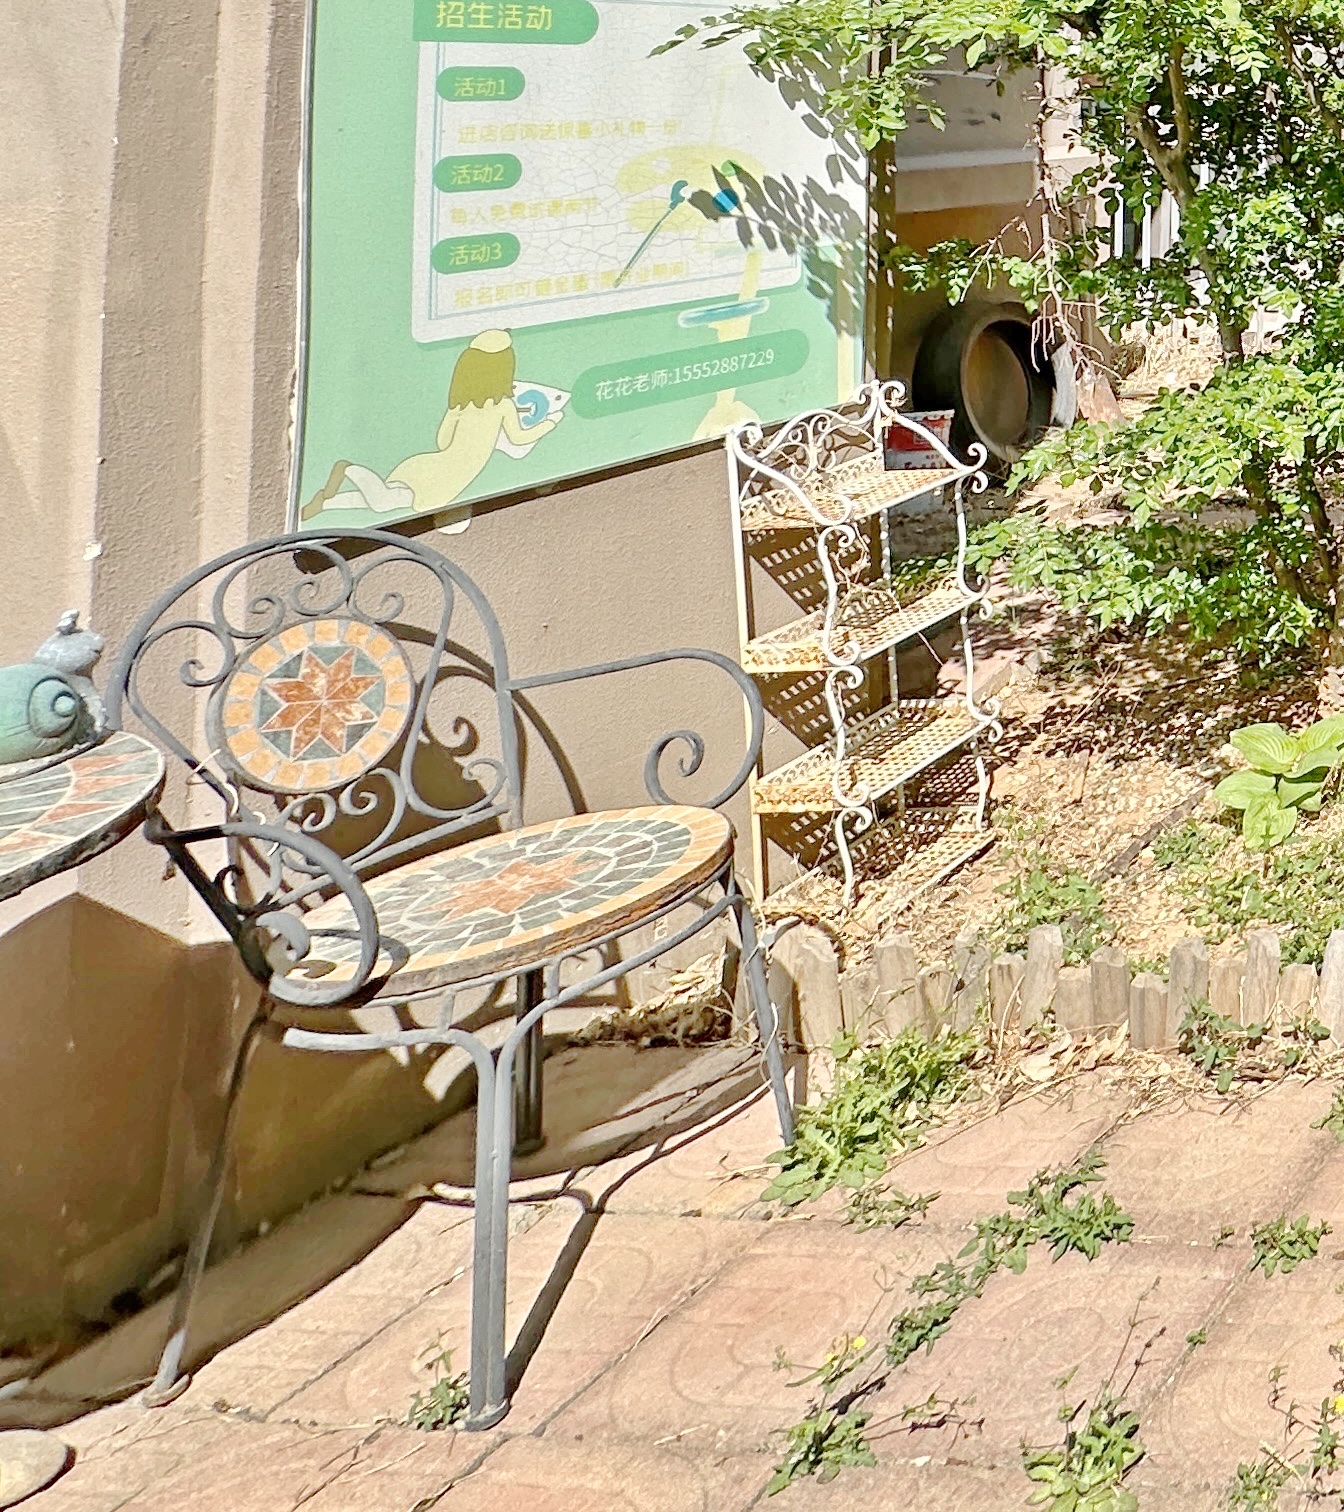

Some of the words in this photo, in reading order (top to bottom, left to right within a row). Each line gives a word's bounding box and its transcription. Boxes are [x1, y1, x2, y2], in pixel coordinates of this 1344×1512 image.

[435, 0, 553, 31] 招生活动
[454, 76, 506, 97] 活动1
[451, 163, 504, 185] 活动2
[450, 243, 503, 267] 活动3
